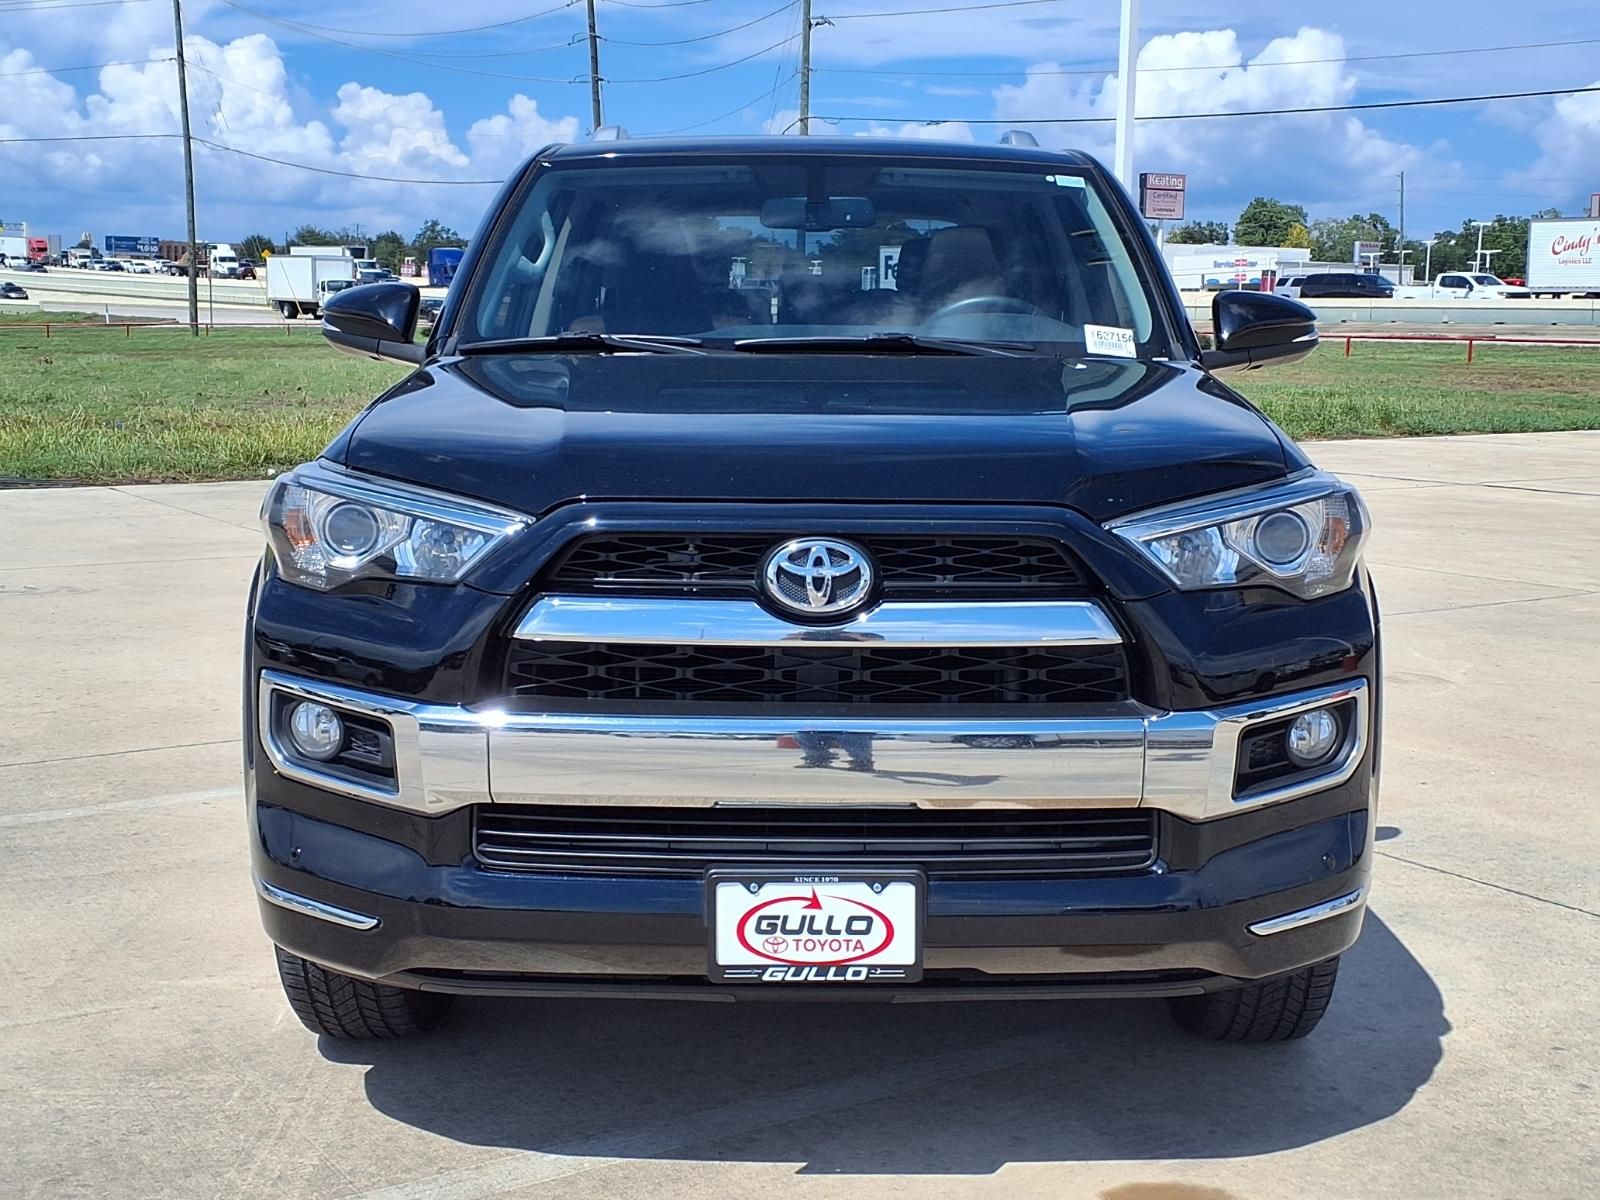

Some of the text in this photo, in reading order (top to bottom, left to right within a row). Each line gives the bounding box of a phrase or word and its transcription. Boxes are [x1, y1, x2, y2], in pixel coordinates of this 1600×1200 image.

[1149, 175, 1183, 188] Keating
[1558, 257, 1581, 266] Logistics
[754, 914, 874, 936] GULLO
[792, 938, 865, 953] TOYOTA
[761, 966, 869, 981] GULLO
